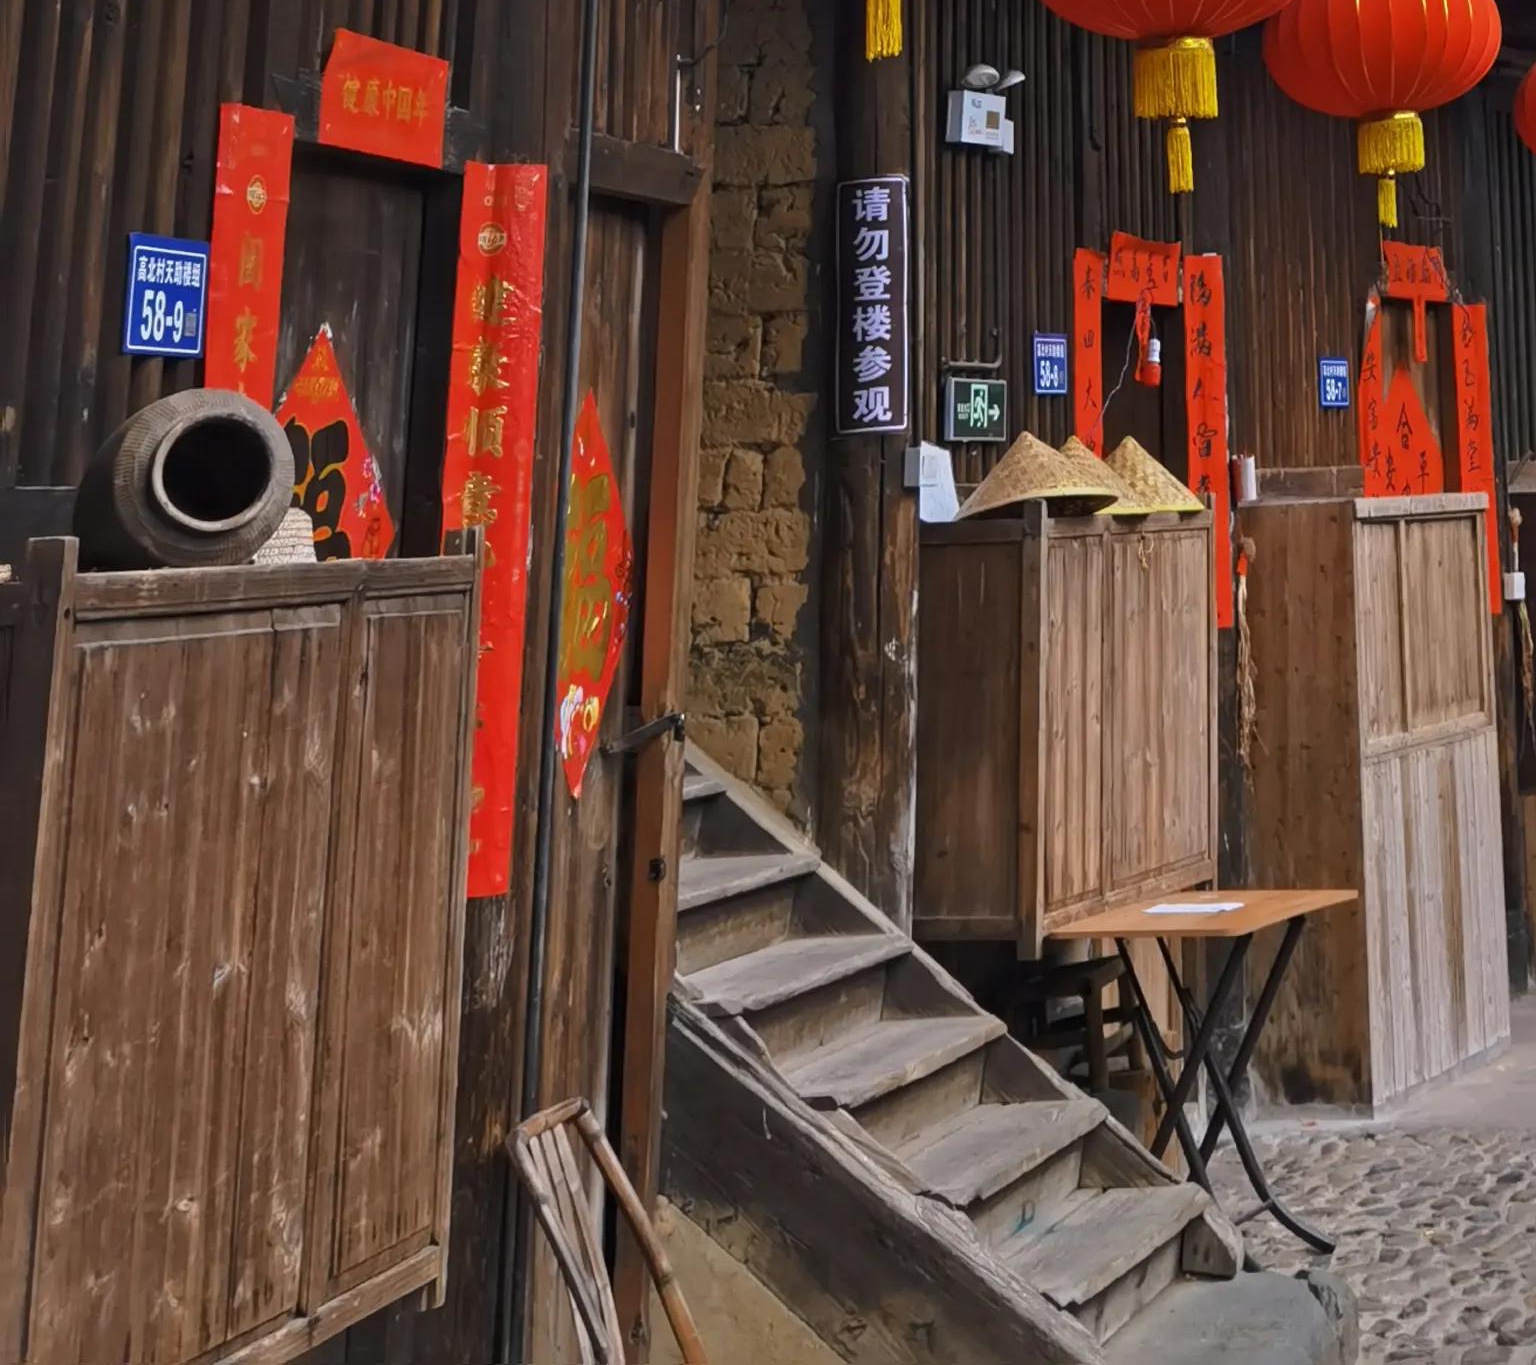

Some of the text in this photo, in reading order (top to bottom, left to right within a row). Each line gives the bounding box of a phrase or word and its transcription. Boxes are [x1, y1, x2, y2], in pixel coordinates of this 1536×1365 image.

[137, 255, 201, 287] 高北村天助楼组
[140, 289, 184, 343] 58-9
[233, 230, 263, 397] 阖家
[852, 185, 893, 423] 请勿登楼参观
[1040, 360, 1059, 388] 58-8
[1326, 378, 1342, 401] 58-7
